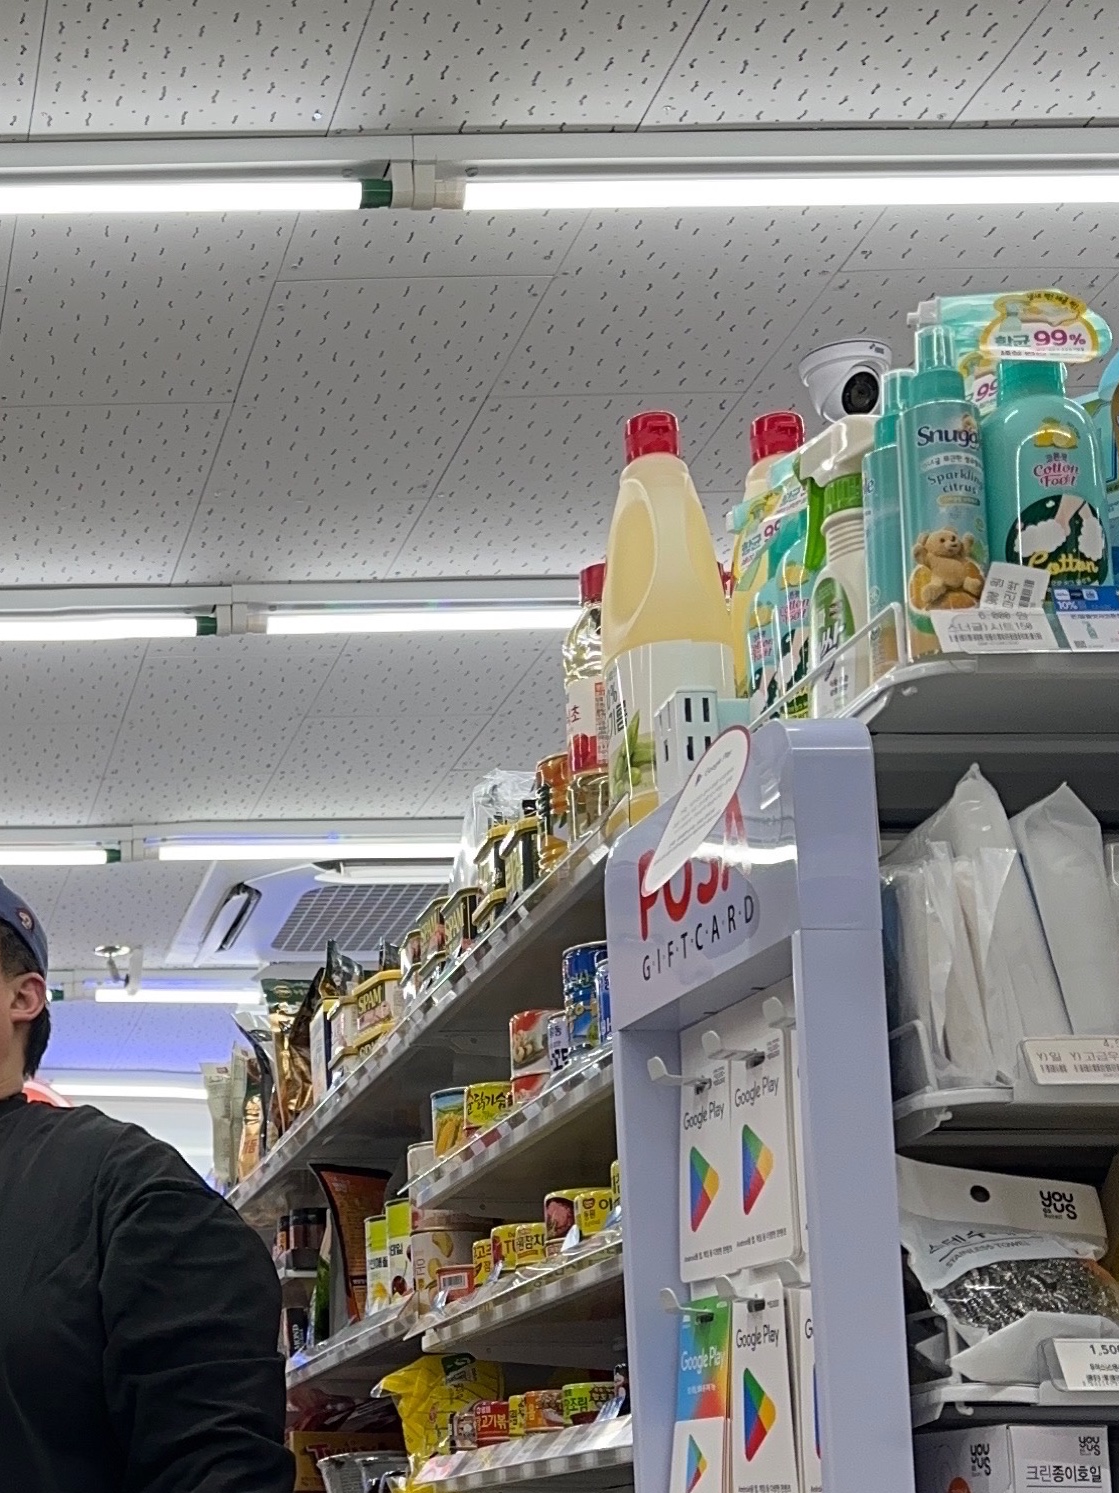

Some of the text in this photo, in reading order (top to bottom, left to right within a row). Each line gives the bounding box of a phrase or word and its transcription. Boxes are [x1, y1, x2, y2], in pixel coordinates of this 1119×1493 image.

[995, 329, 1087, 347] 항균 99%
[1032, 463, 1079, 477] Cotton
[943, 482, 977, 495] citrus
[1058, 600, 1079, 610] 10%
[357, 989, 382, 1013] SPAM
[734, 1075, 780, 1108] Google Play
[683, 1101, 725, 1132] Google Play
[736, 1323, 779, 1352] Google Play
[681, 1350, 709, 1375] Google
[1026, 1465, 1102, 1483] 크린종이호일
